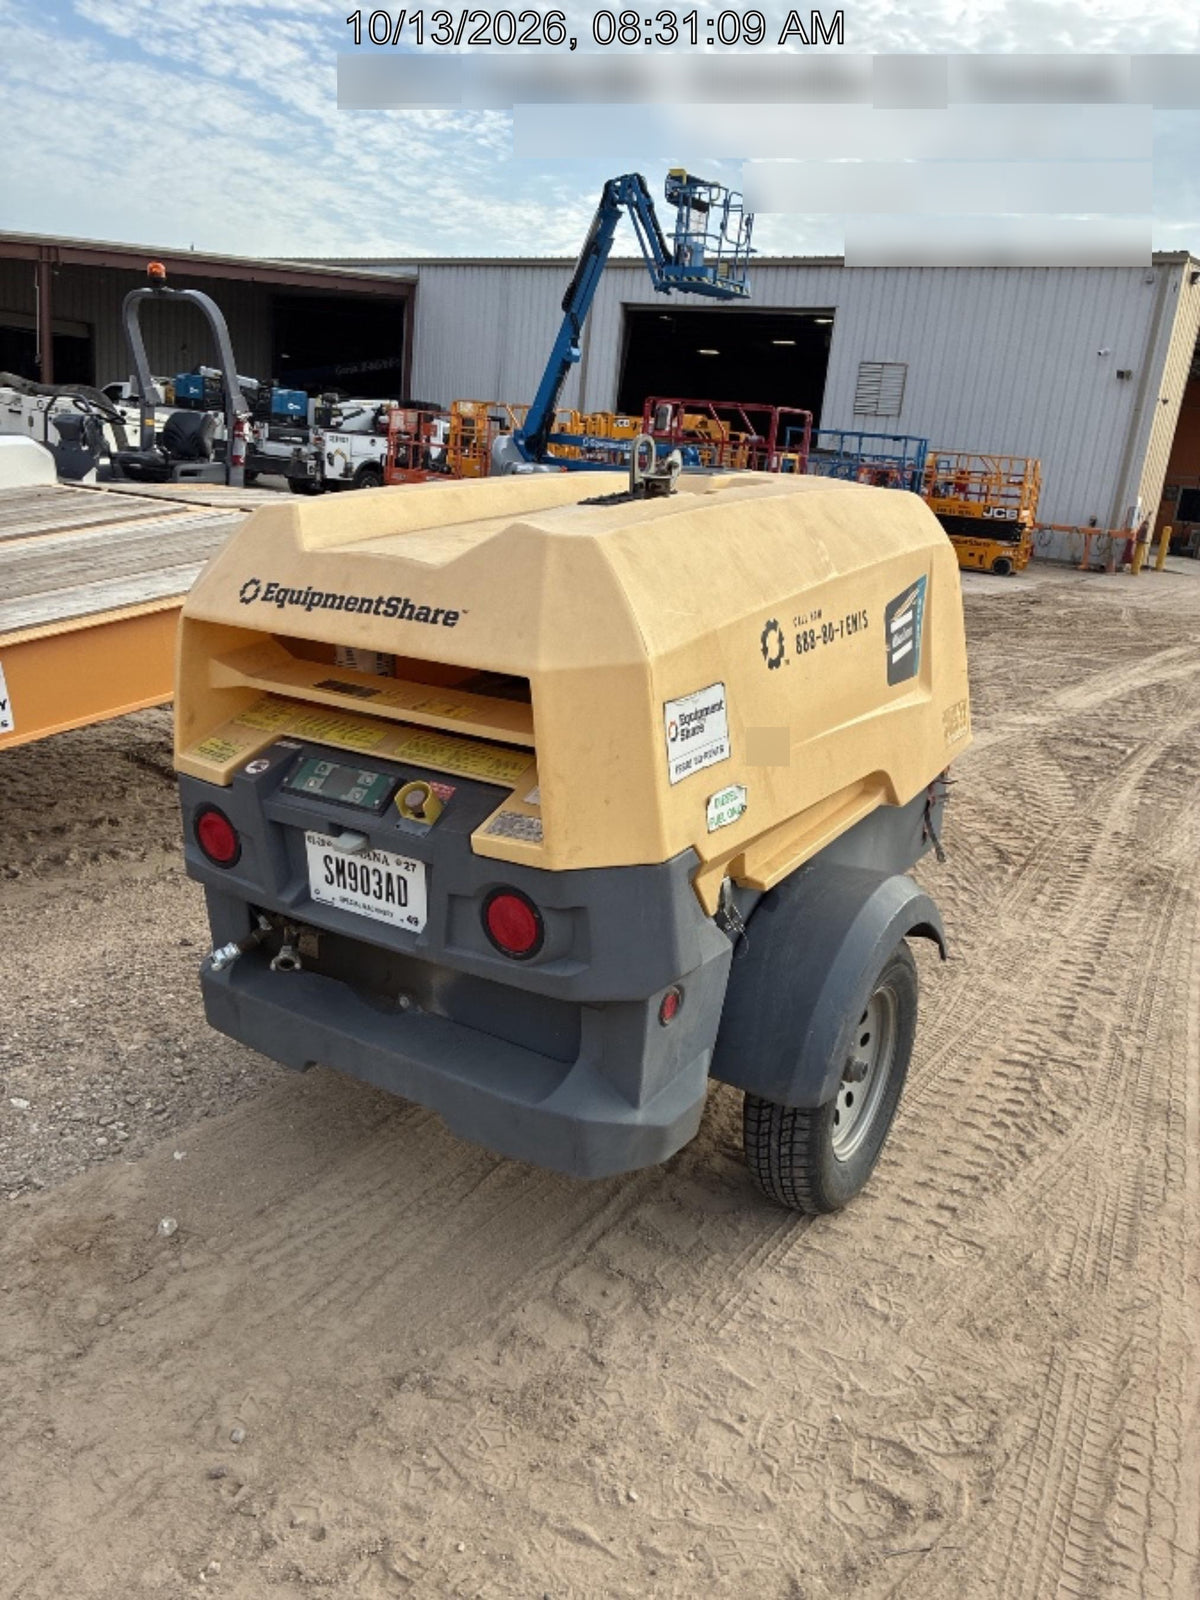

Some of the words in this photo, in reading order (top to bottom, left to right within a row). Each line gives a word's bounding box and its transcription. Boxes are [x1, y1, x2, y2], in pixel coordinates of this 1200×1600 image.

[983, 506, 1018, 520] JCB
[261, 583, 459, 628] EquipmentShare
[323, 854, 408, 907] SM903AD
[404, 861, 417, 873] 27
